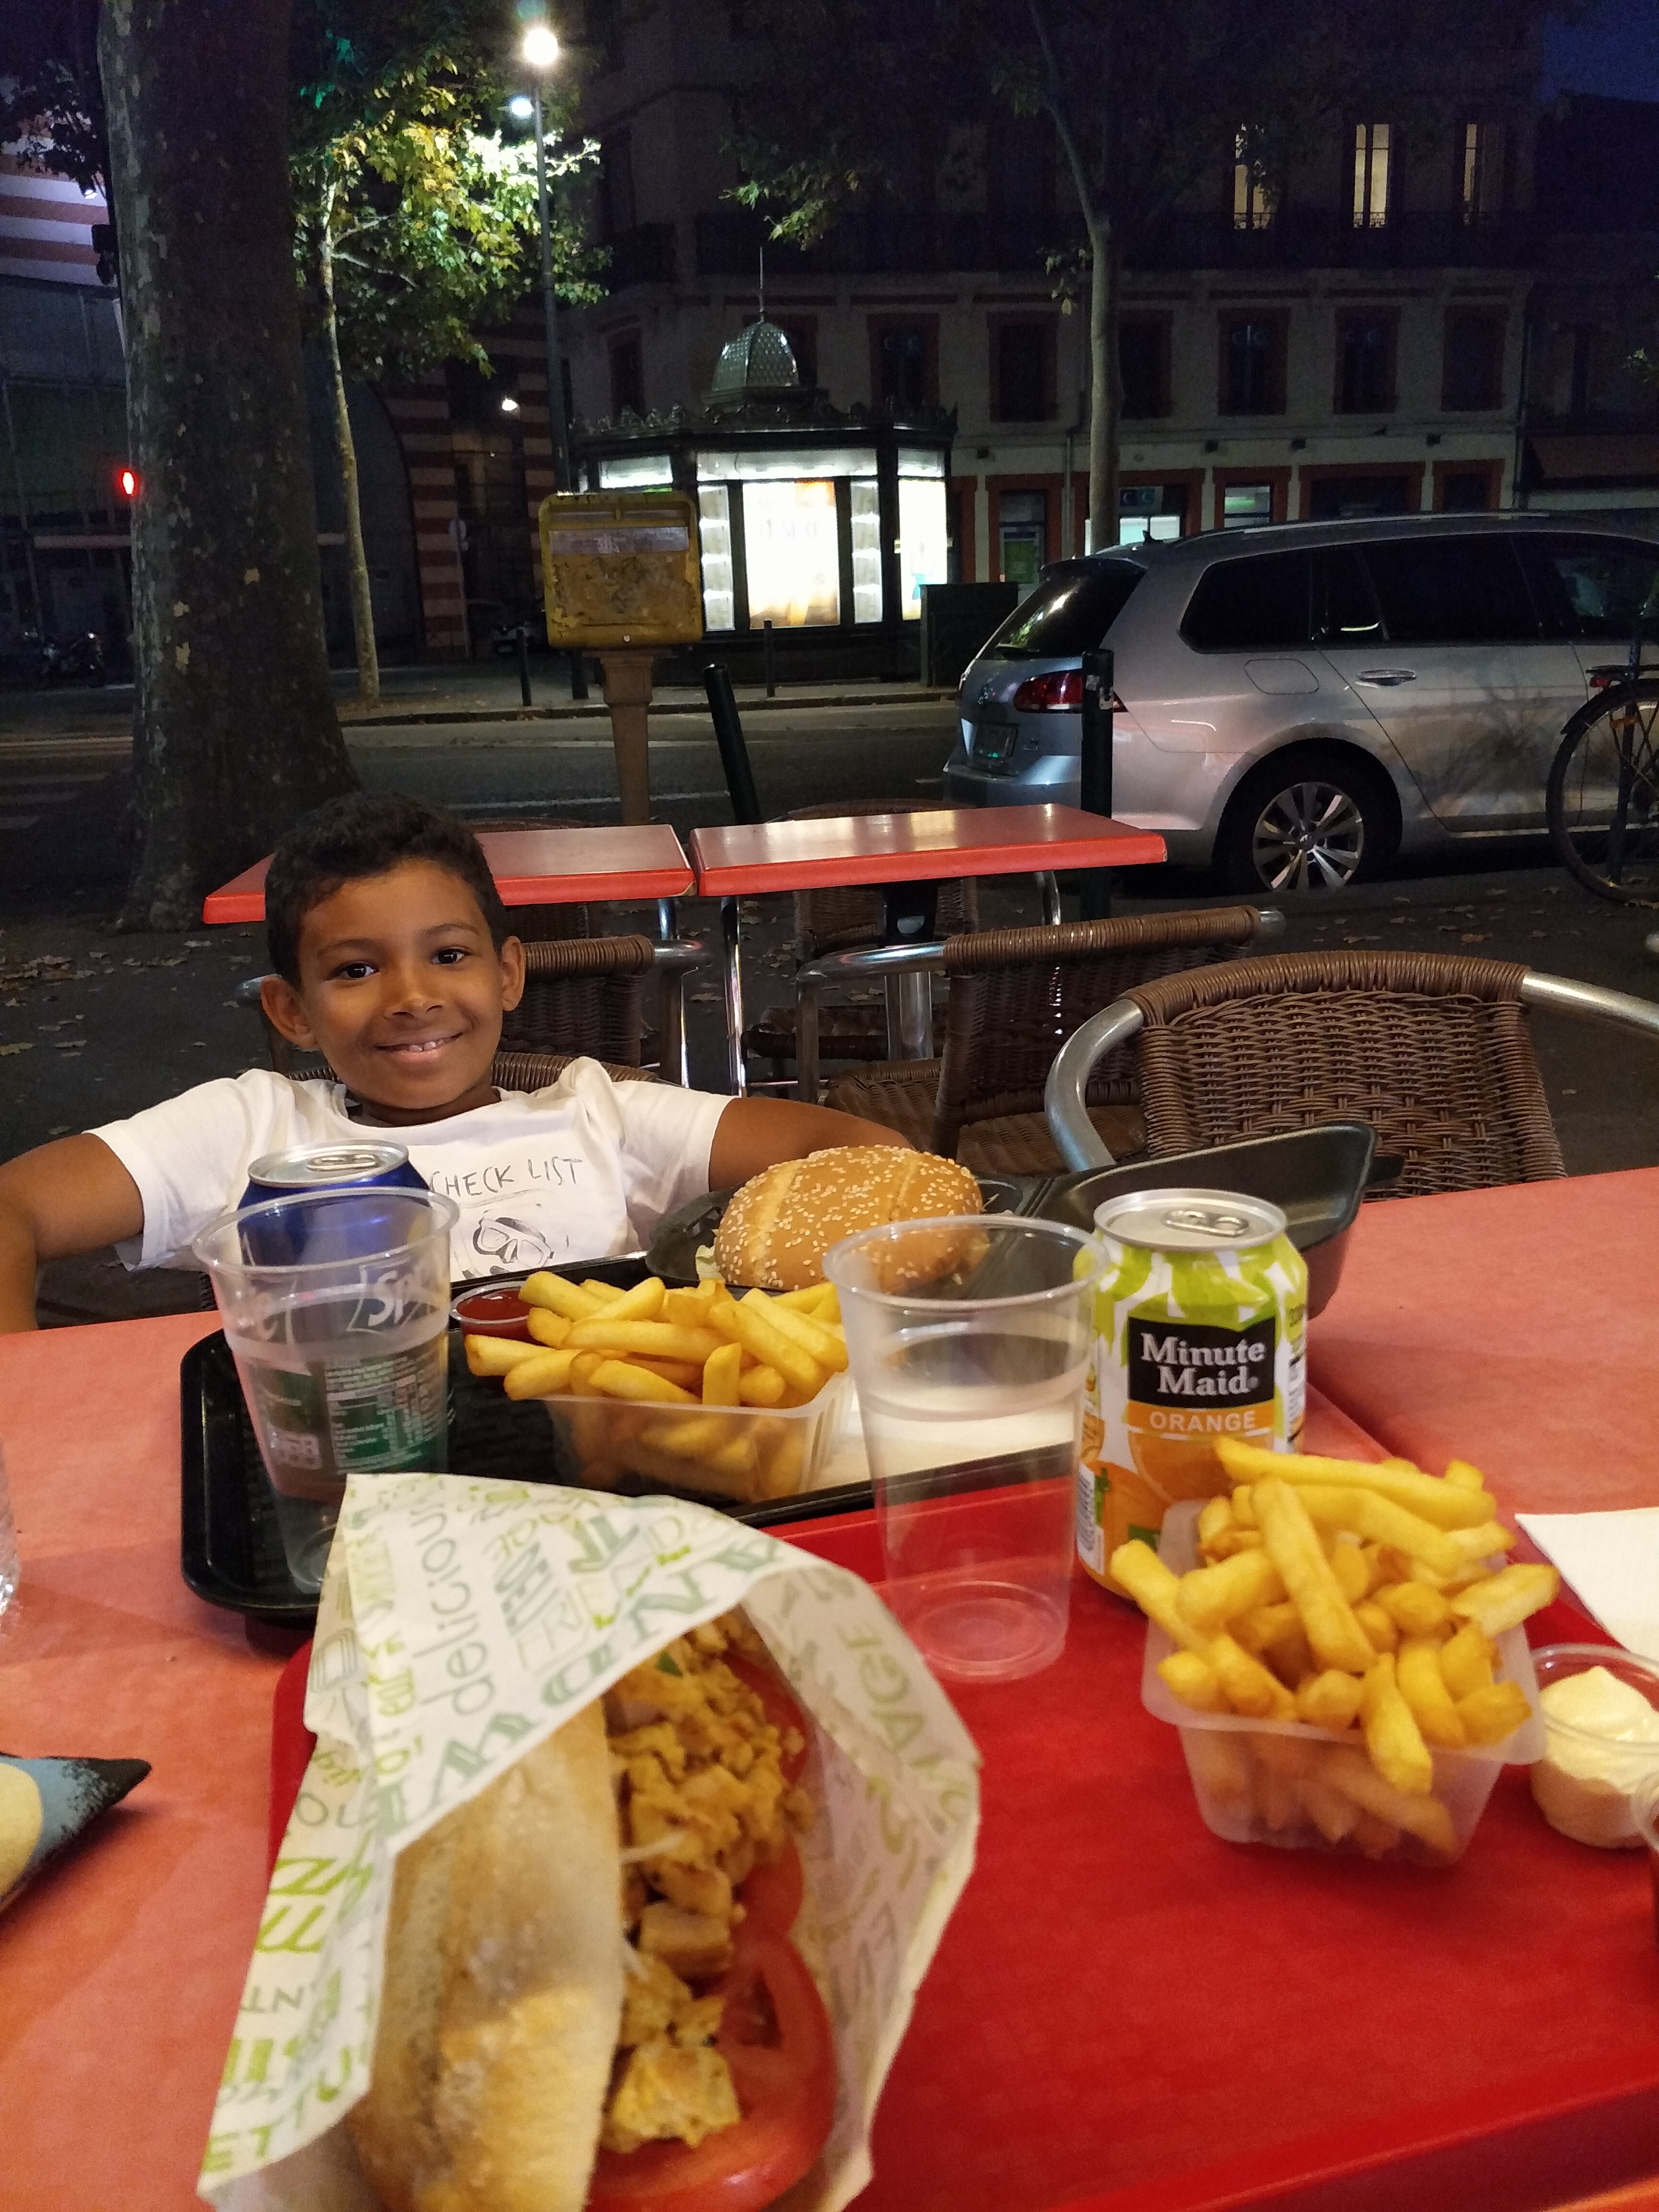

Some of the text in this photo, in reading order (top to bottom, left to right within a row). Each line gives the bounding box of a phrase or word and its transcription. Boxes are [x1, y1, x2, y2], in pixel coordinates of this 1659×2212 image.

[429, 1155, 583, 1197] CHECK LIST
[1140, 1332, 1267, 1366] Minute
[1156, 1366, 1250, 1396] Maid
[1149, 1410, 1255, 1432] ORANGE
